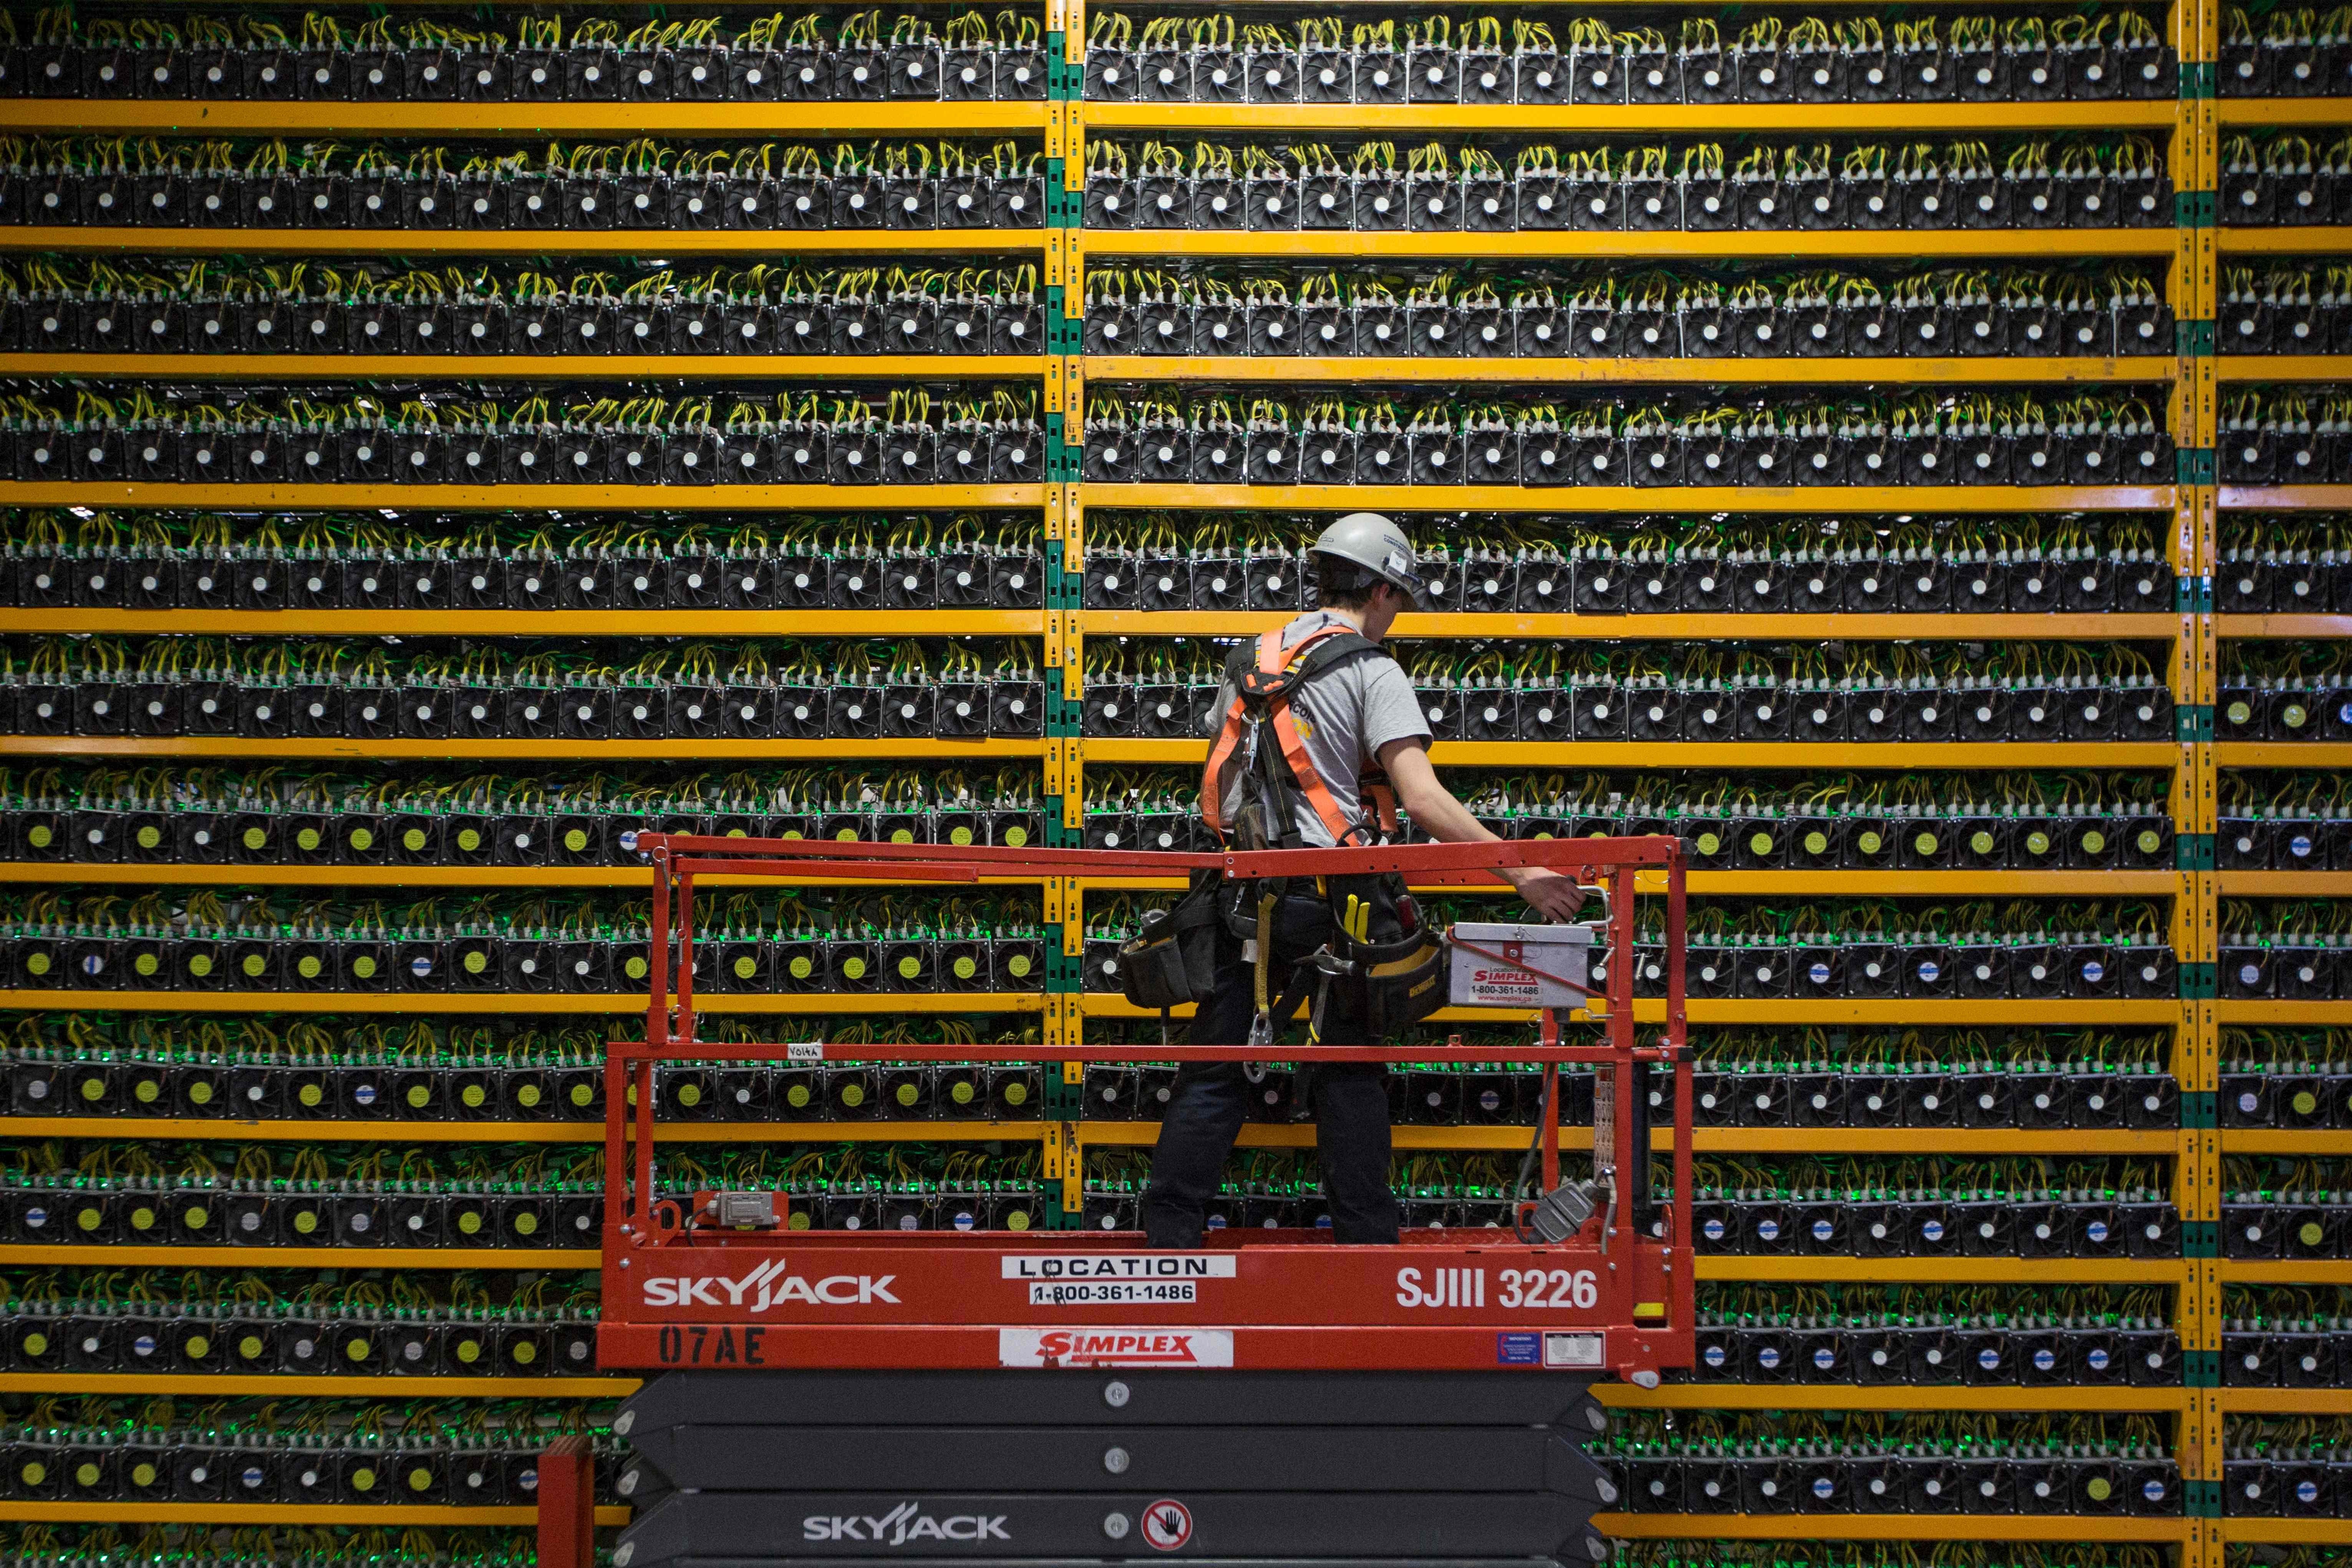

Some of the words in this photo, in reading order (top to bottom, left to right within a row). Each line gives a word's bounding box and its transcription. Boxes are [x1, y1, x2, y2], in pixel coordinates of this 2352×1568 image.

[1472, 985, 1539, 994] 1-800-361-1486
[1473, 970, 1538, 985] SIMPLEX
[1020, 1258, 1208, 1276] LOCATION
[643, 1258, 902, 1313] SKYJACK
[1034, 1285, 1193, 1301] 1-800-361-1486
[1396, 1267, 1485, 1308] SJIII
[1498, 1269, 1597, 1308] 3226
[1034, 1332, 1198, 1362] SIMPLEX
[802, 1501, 1011, 1546] SKYJACK
